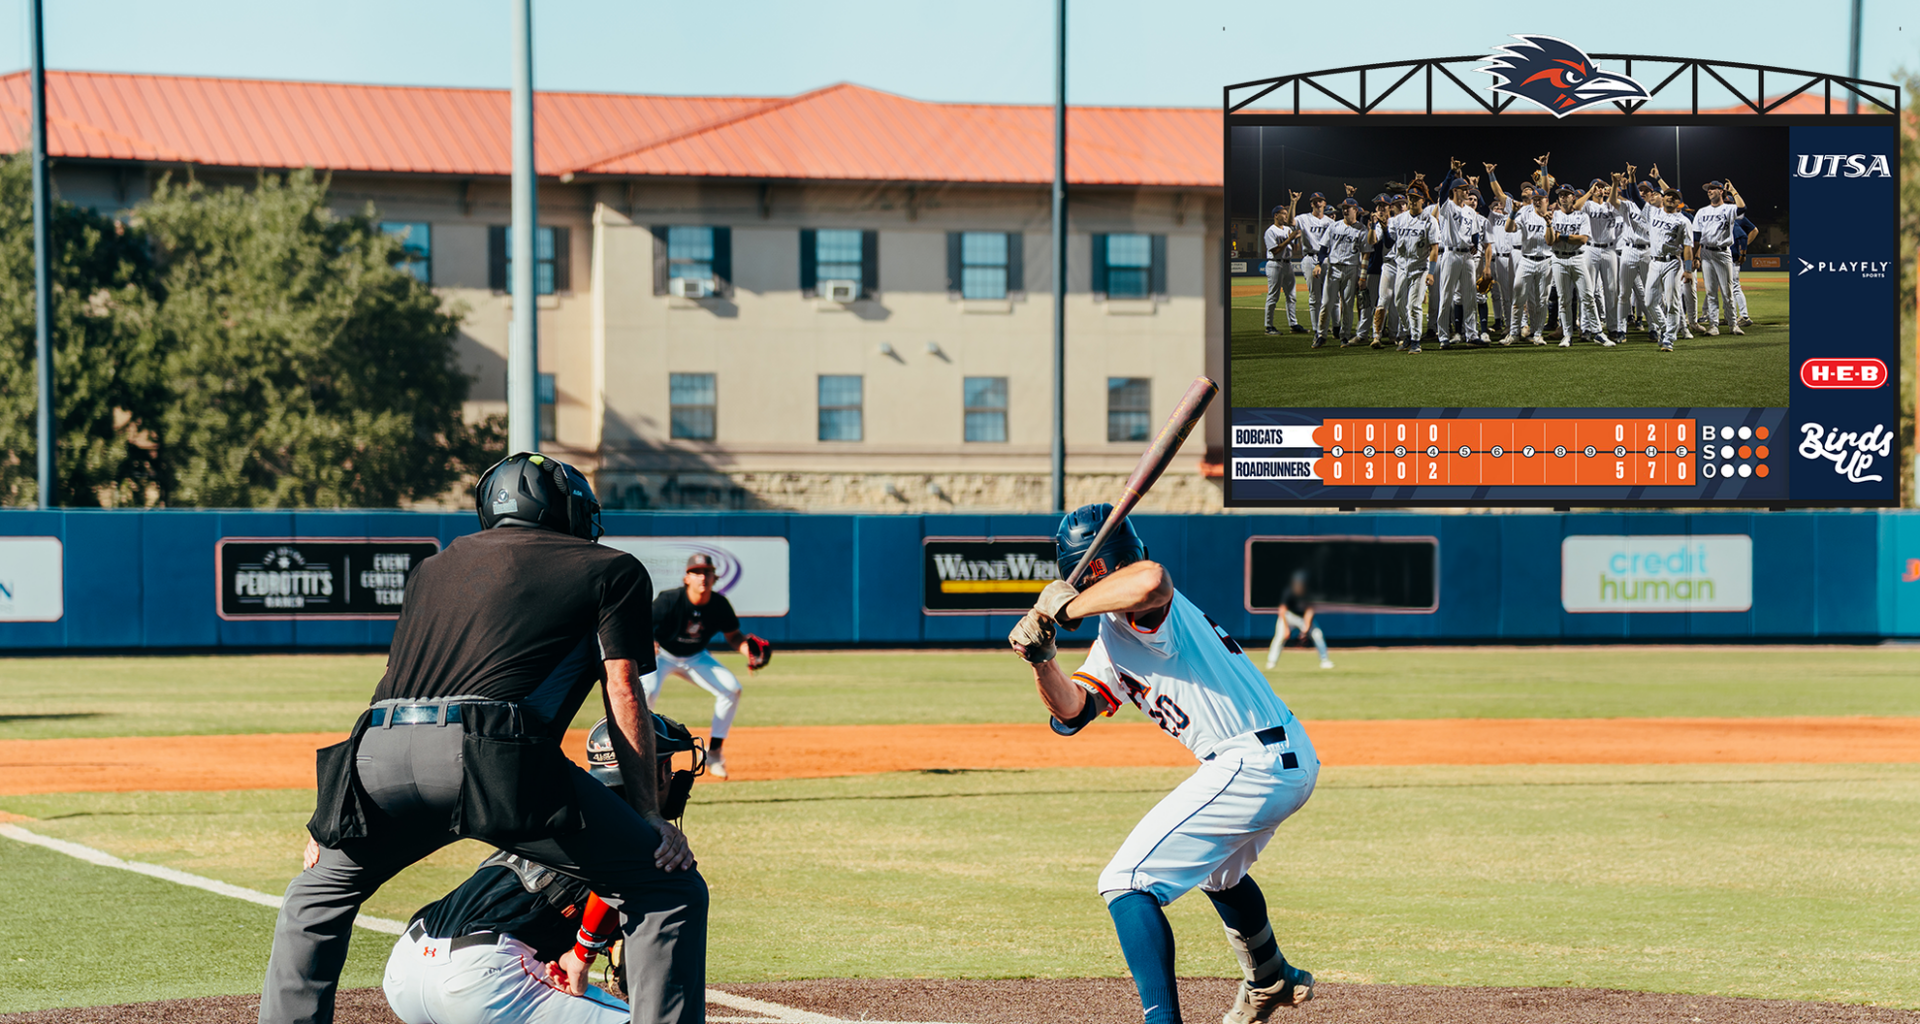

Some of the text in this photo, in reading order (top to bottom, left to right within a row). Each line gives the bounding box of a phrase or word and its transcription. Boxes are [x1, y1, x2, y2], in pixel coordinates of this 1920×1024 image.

[1797, 153, 1892, 178] UTSA
[1652, 219, 1679, 231] UTSA
[1703, 214, 1727, 222] UTSA
[1398, 228, 1425, 238] UTSA
[1818, 261, 1888, 272] PLAYFLY
[1811, 365, 1879, 381] H-E-B
[1235, 424, 1686, 445] BOBCATS 0 0 0 0 0 2 0
[1702, 426, 1716, 440] B
[1798, 422, 1894, 460] Birds
[1702, 444, 1716, 460] S
[1235, 461, 1686, 480] ROADRUNNERS 0 3 0 2 5 7 0
[1702, 463, 1716, 478] O
[1834, 450, 1883, 483] Up
[373, 554, 411, 571] EVENT
[1609, 545, 1707, 574] credit
[235, 571, 333, 596] PEDROTTI'S
[360, 571, 404, 588] CENTER
[1600, 573, 1715, 601] human
[374, 589, 405, 605] TEXA
